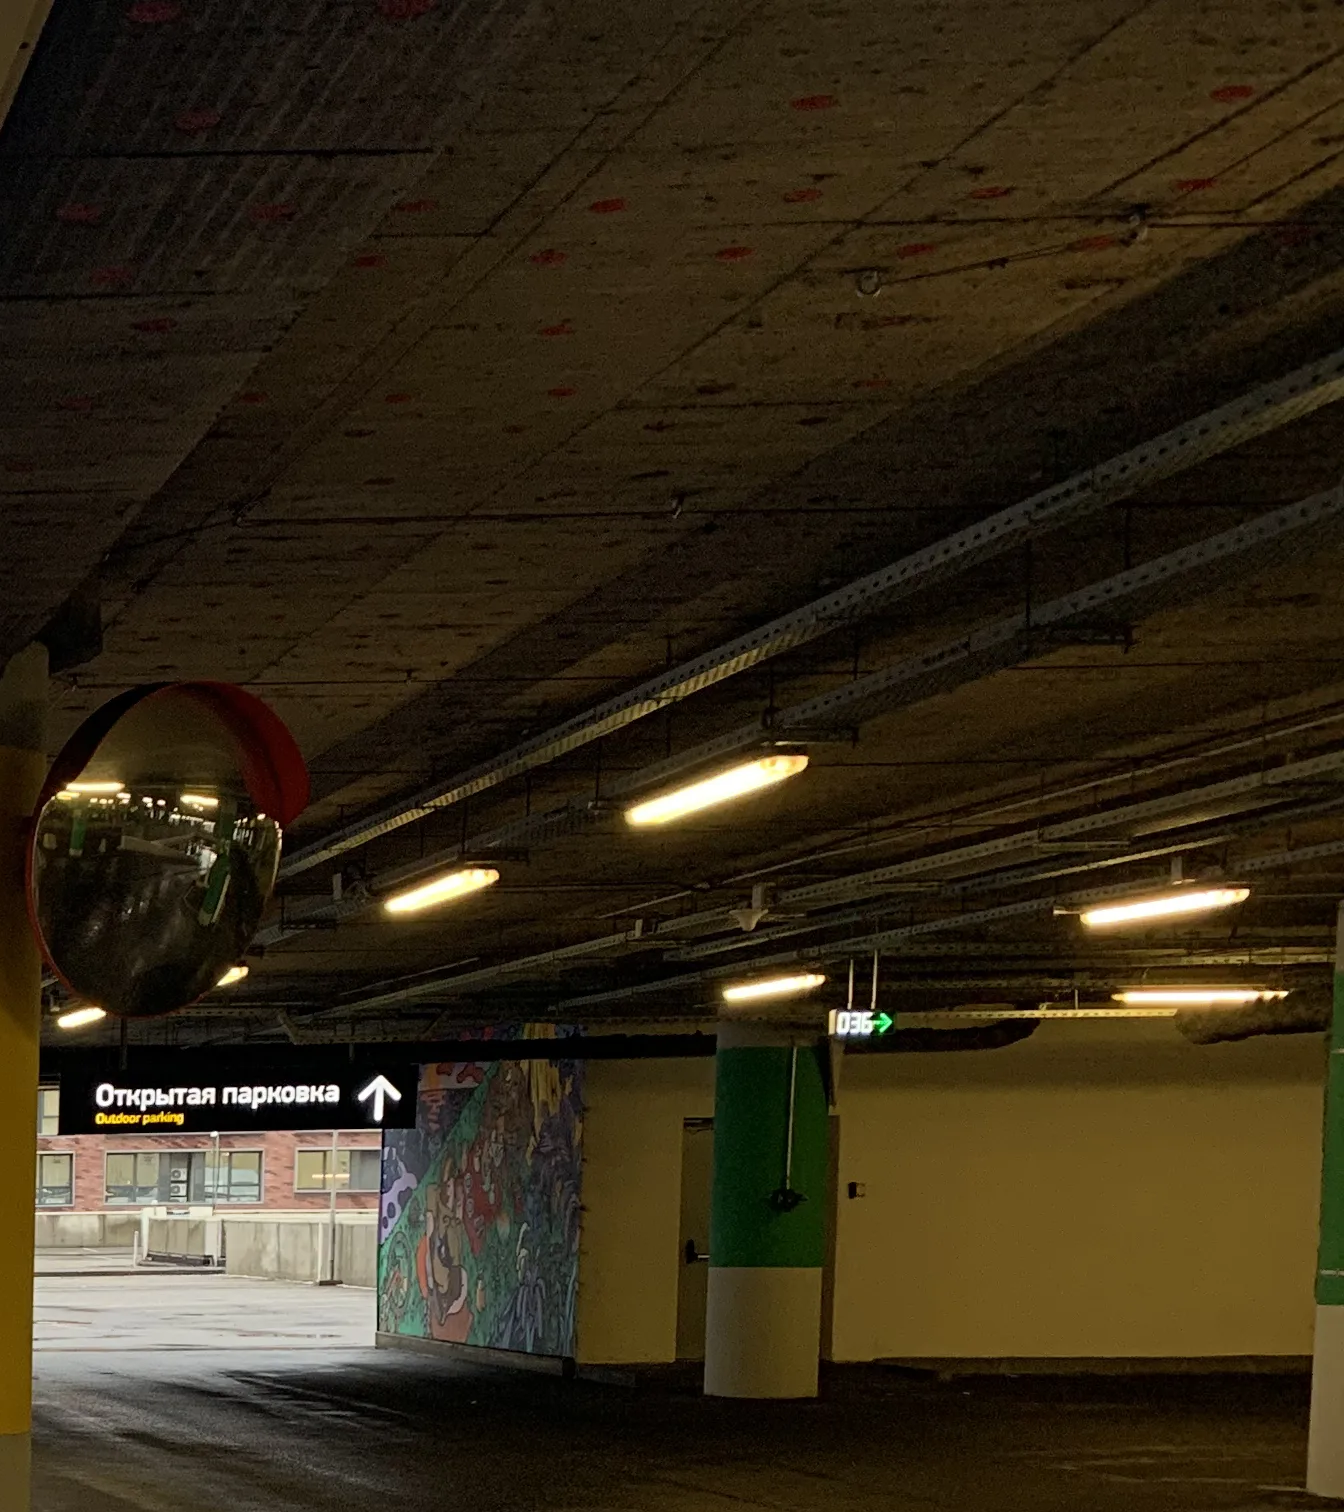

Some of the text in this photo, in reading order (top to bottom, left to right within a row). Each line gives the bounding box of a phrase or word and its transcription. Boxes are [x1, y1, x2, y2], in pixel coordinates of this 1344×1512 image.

[836, 1011, 874, 1034] 036
[95, 1082, 340, 1111] Открытая парковка
[95, 1110, 185, 1126] Outdoor parking
